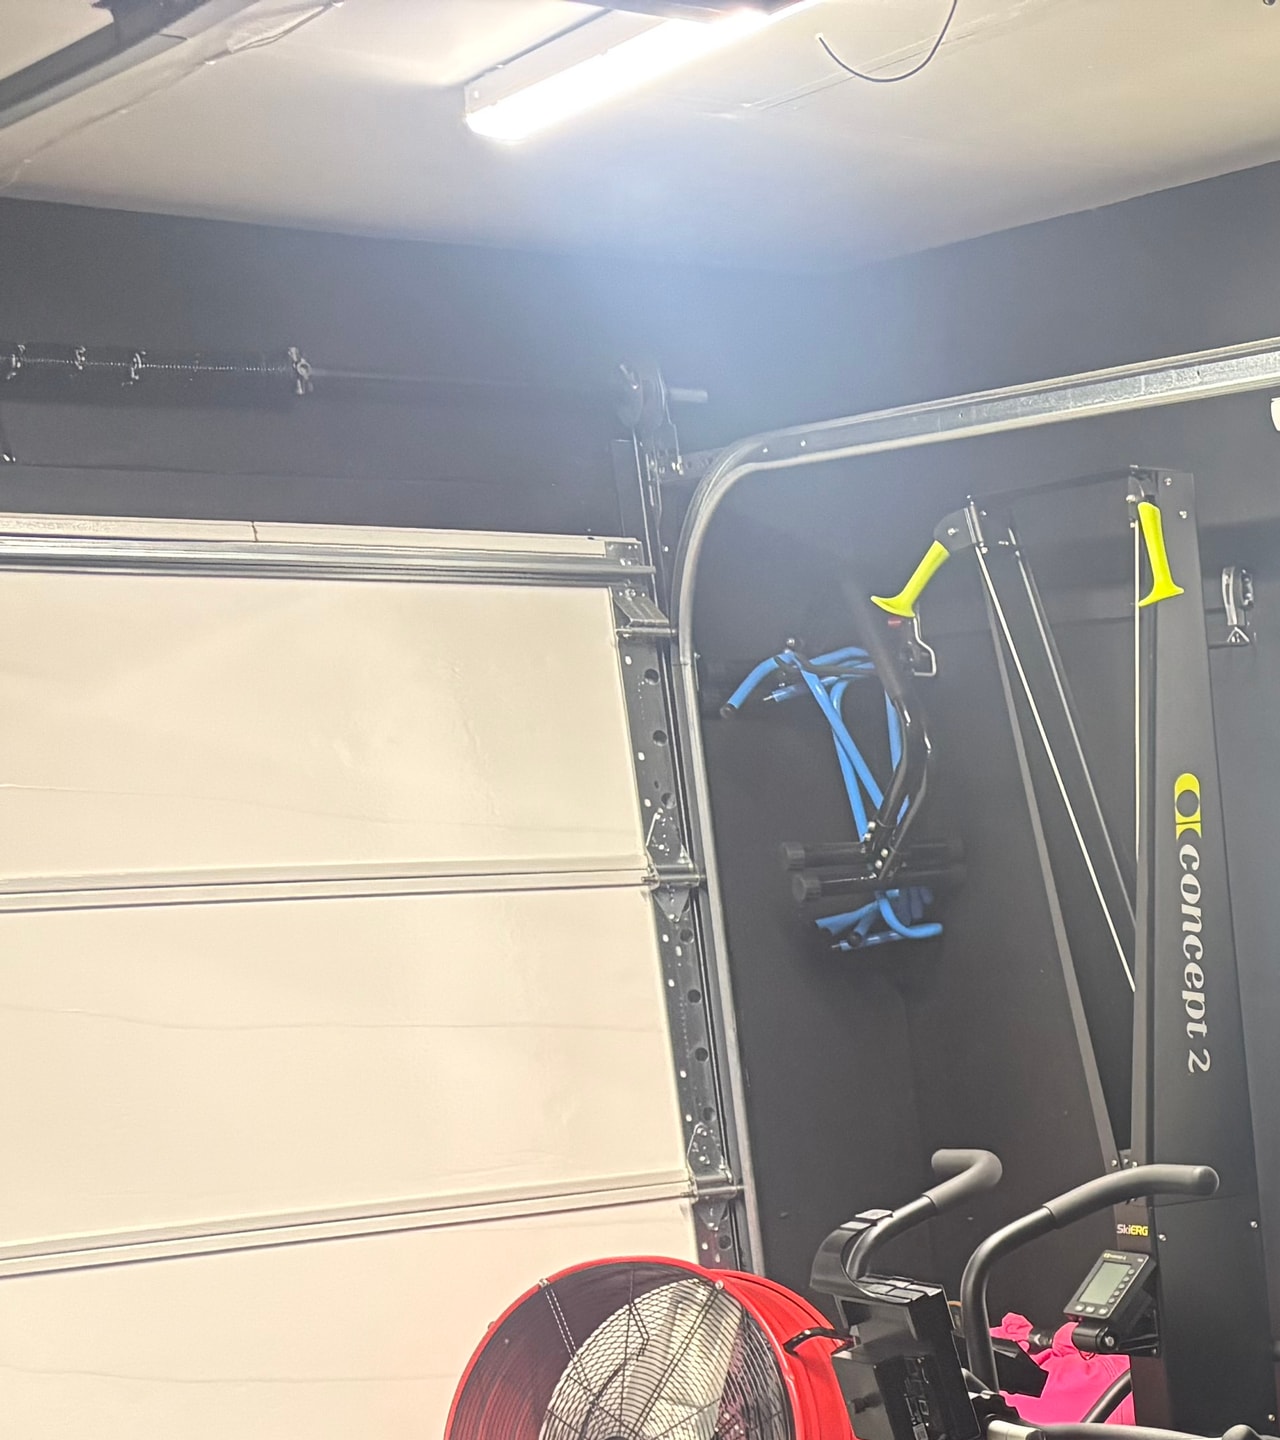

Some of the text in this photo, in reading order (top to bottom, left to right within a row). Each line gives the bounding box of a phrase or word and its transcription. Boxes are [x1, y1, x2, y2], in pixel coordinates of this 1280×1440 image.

[1179, 844, 1211, 1074] concept 2
[1116, 1224, 1149, 1236] SkiERG
